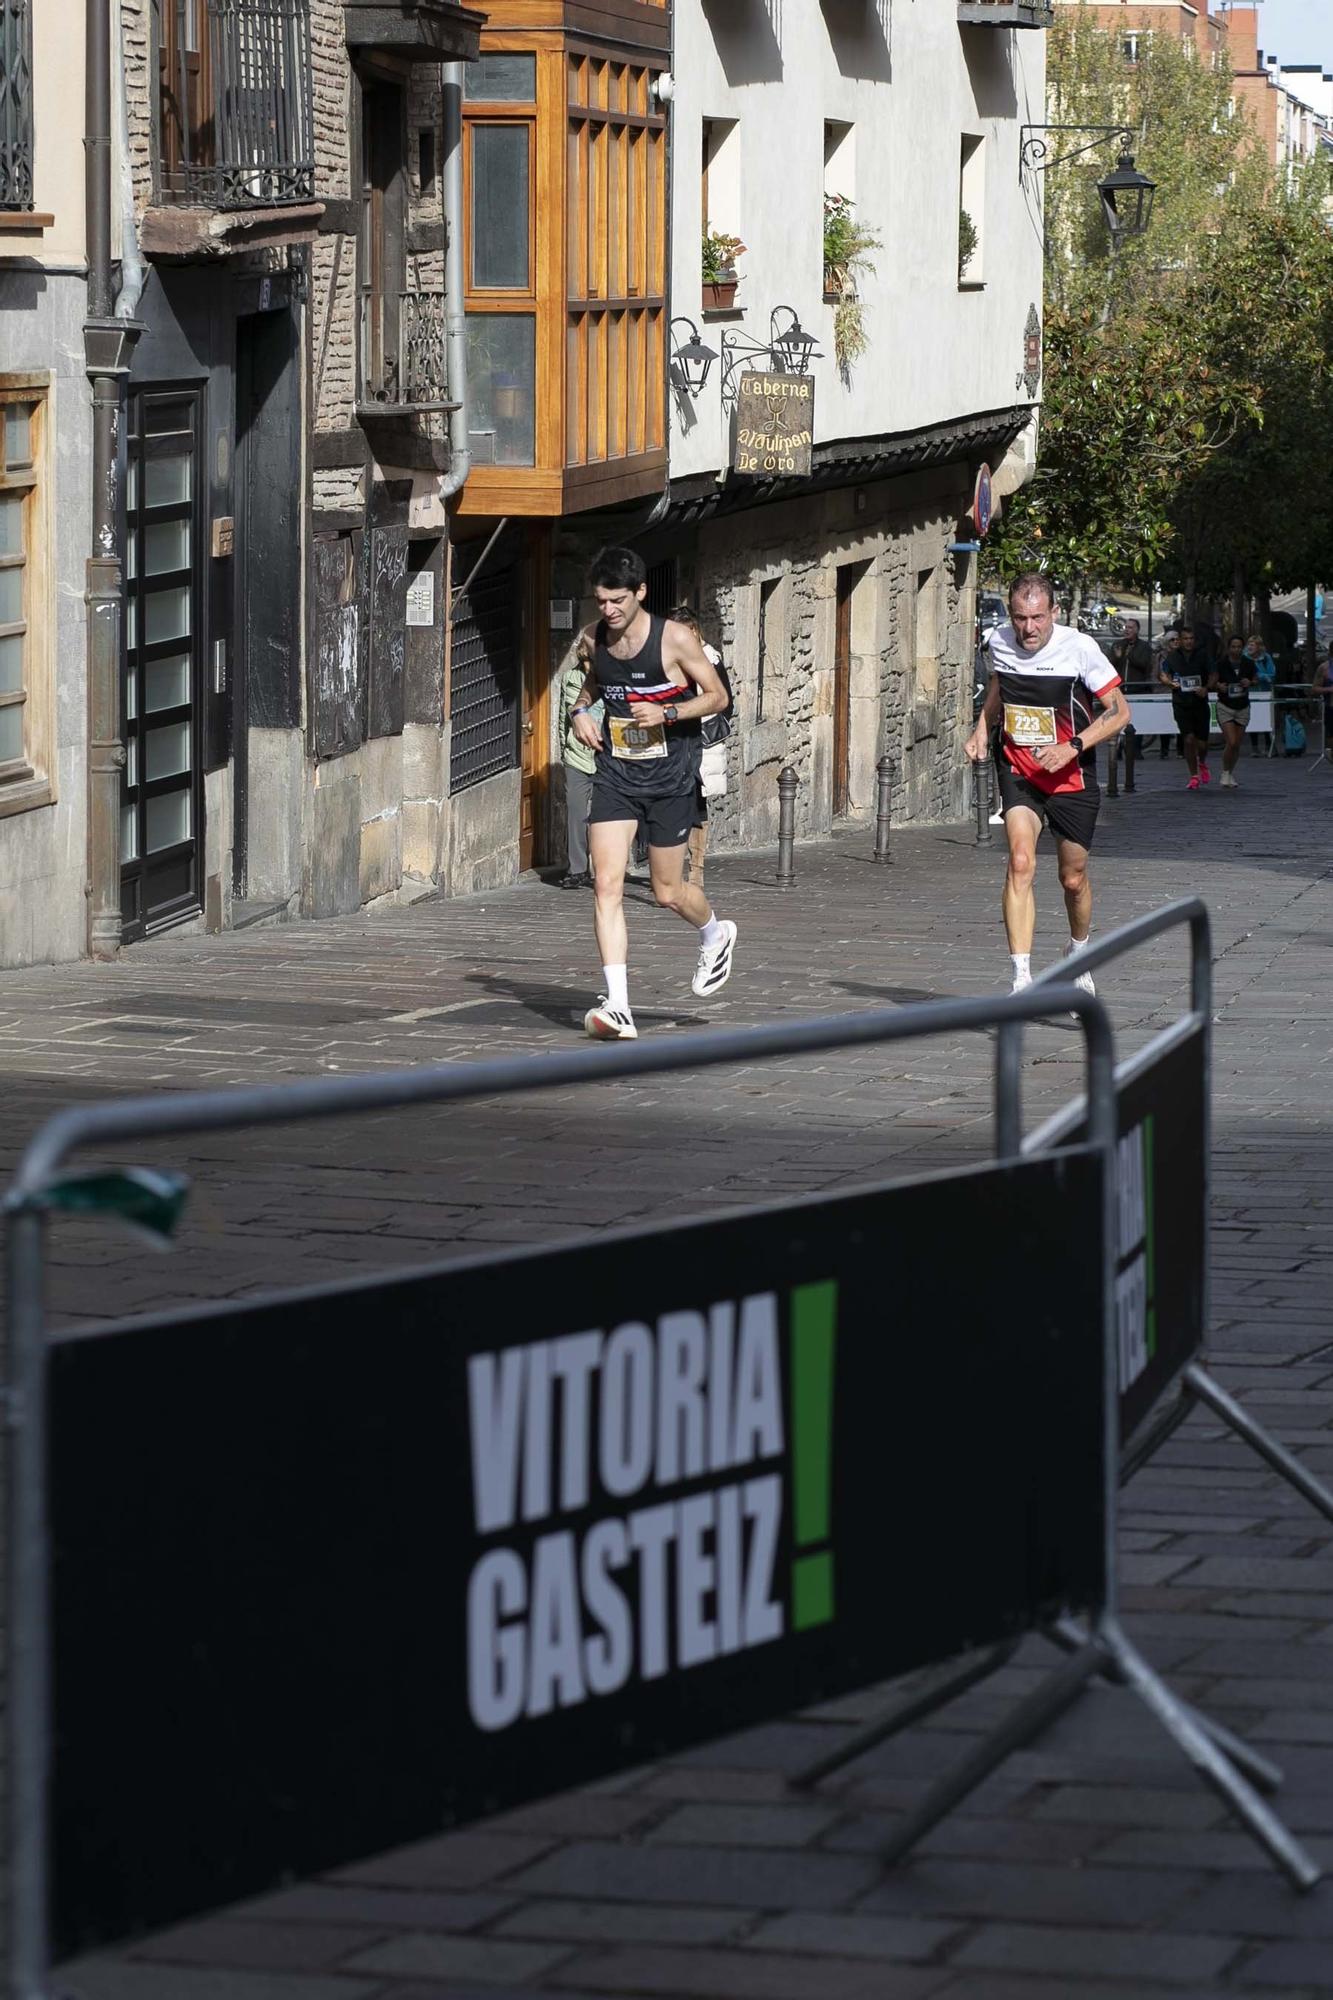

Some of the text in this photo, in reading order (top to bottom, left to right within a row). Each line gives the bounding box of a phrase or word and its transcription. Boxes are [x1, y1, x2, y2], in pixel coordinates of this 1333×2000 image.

[741, 377, 809, 398] Taberna
[739, 452, 795, 471] De Oro
[1014, 715, 1041, 732] 223
[623, 727, 648, 745] 169
[468, 1291, 785, 1536] VITORIA
[467, 1472, 784, 1732] GASTEIZ
